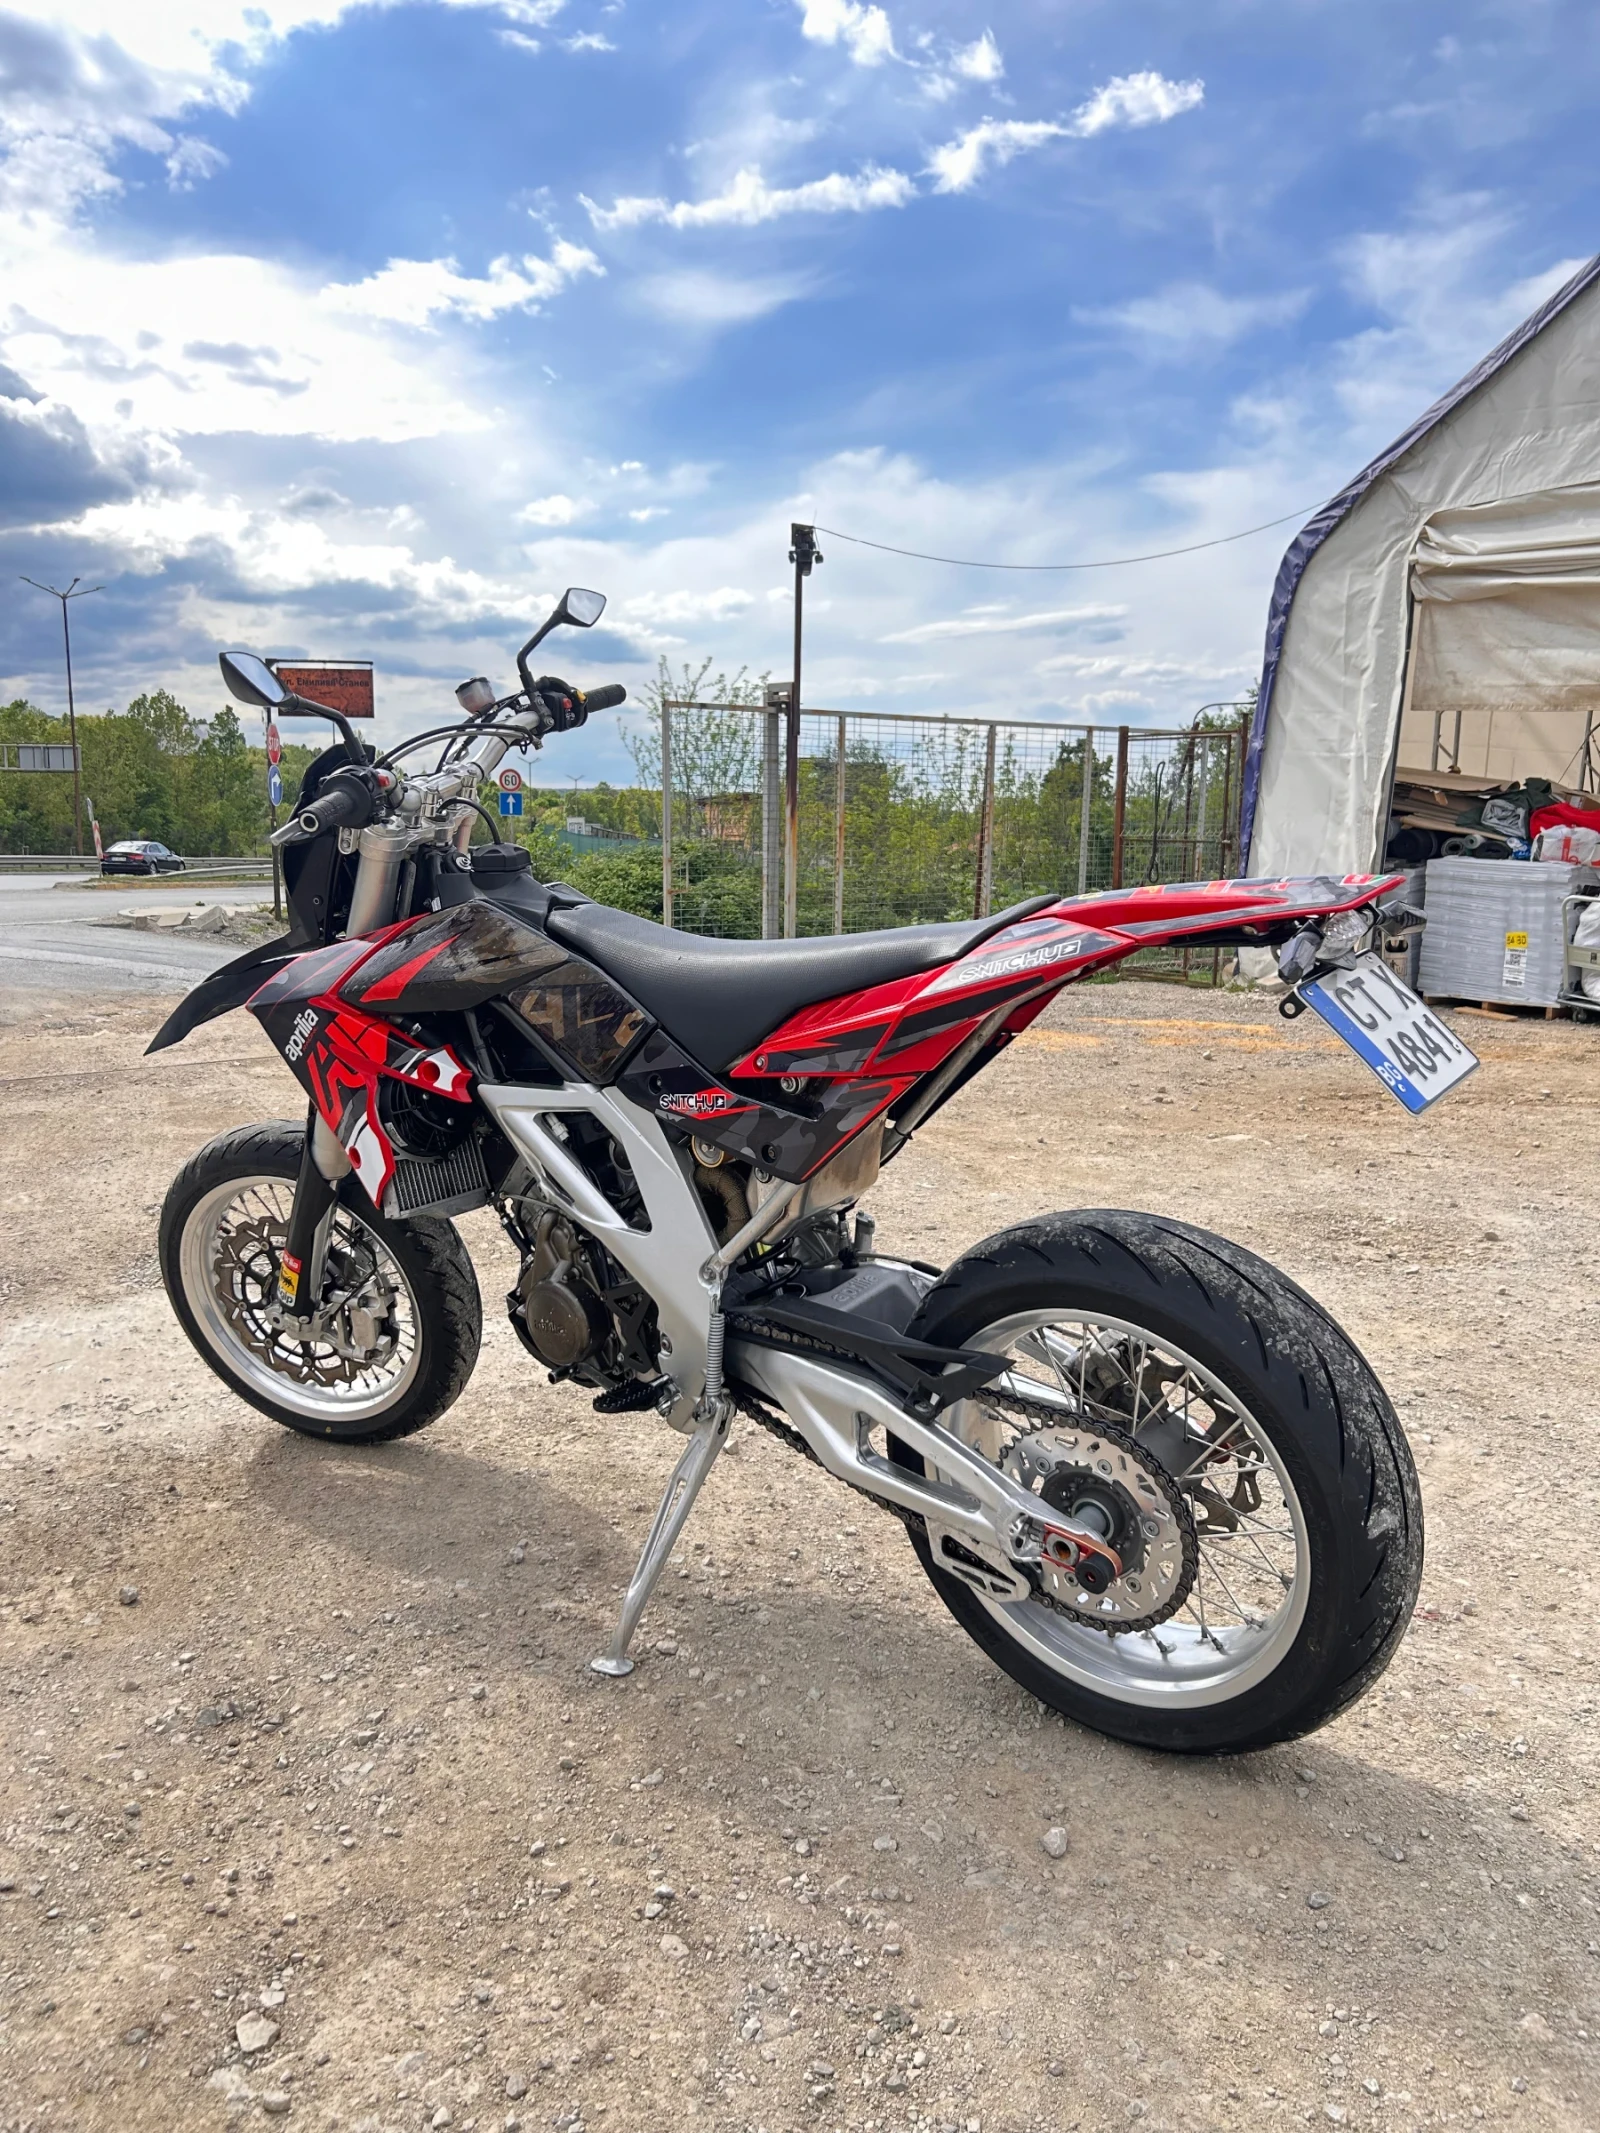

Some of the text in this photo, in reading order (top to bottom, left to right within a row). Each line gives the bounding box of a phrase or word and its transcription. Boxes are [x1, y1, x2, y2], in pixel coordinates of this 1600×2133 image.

[504, 774, 517, 786] 60
[1333, 964, 1418, 1032] CT X
[285, 1008, 320, 1062] aprilia
[1386, 1013, 1462, 1082] 4841
[1375, 1061, 1403, 1087] BG
